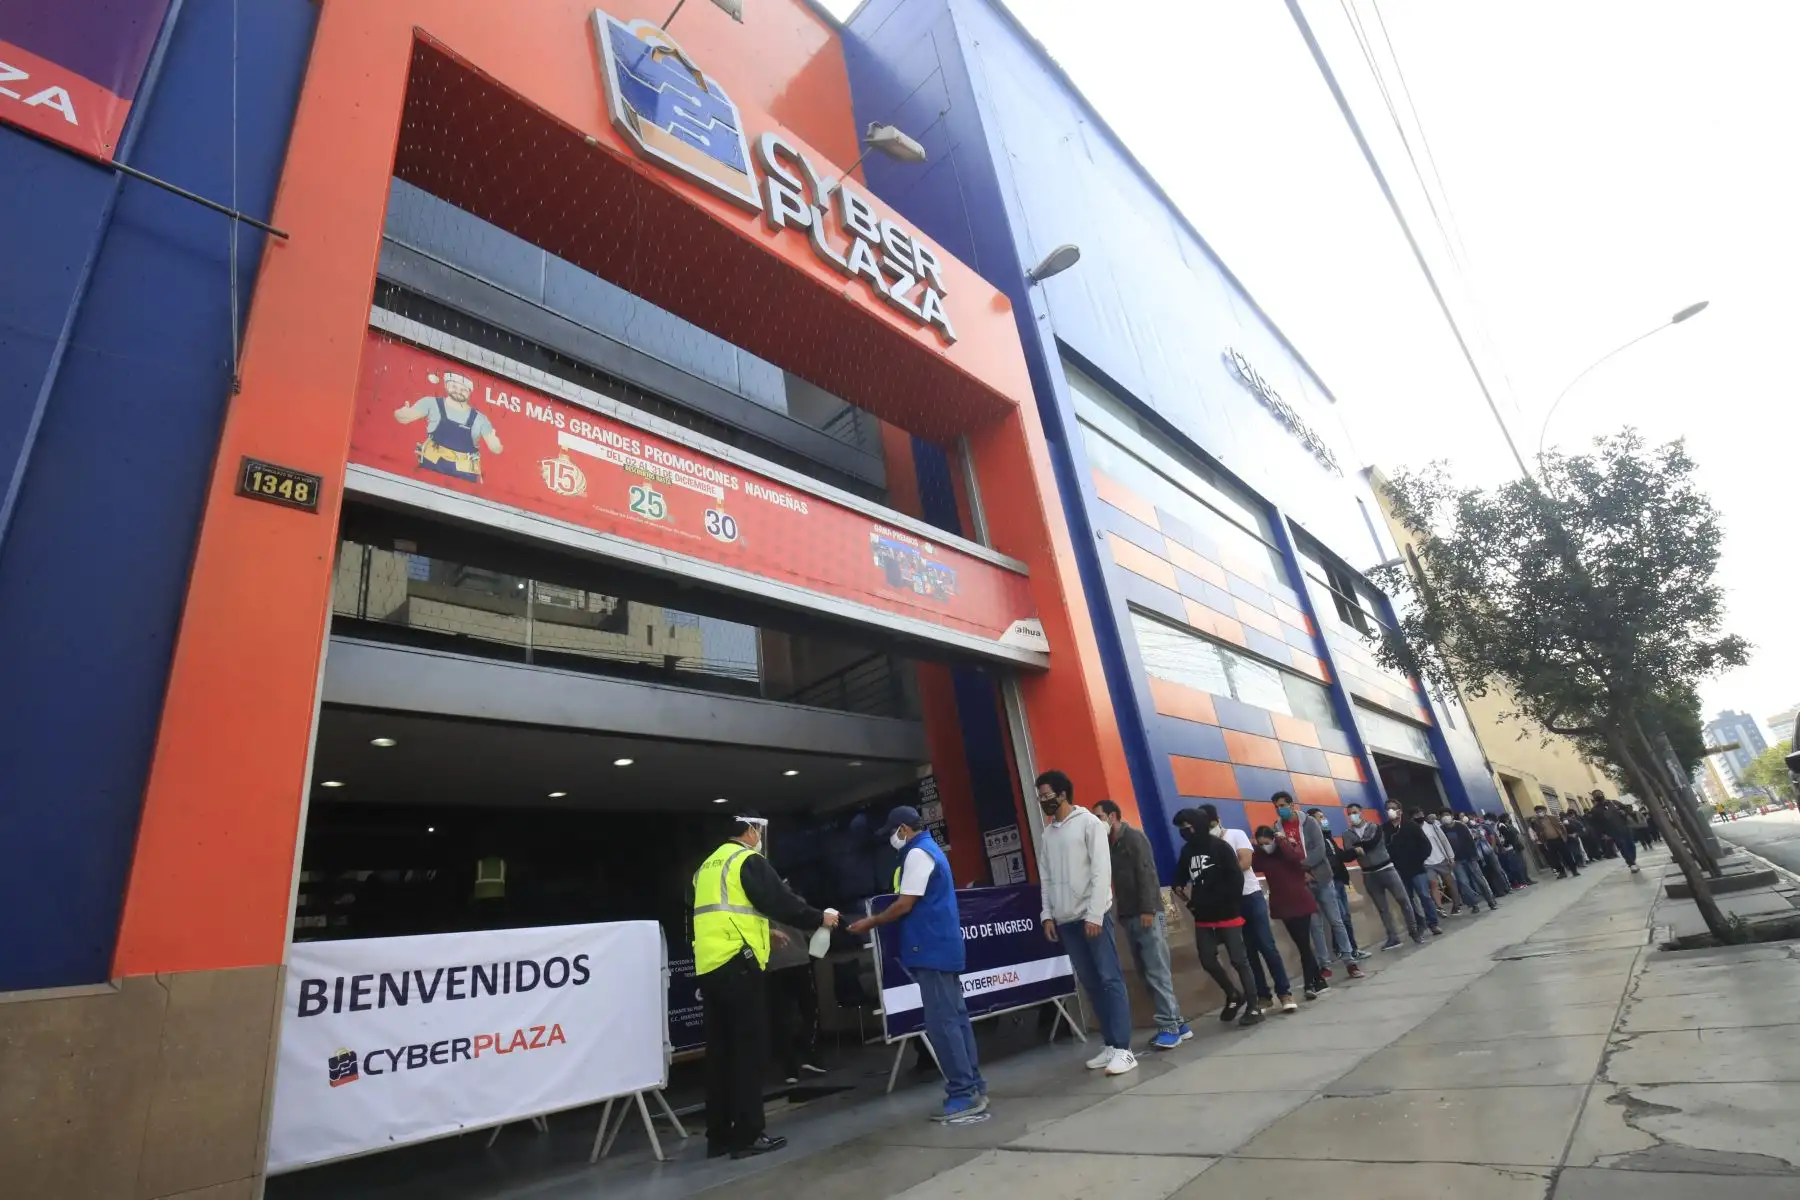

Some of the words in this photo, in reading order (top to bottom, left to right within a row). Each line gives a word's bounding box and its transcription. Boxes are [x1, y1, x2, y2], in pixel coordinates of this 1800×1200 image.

[757, 131, 948, 297] CYBER
[766, 175, 957, 343] PLAZA
[485, 387, 521, 413] LAS
[526, 402, 565, 429] MÁS
[569, 419, 640, 455] GRANDES
[644, 444, 739, 490] PROMOCIONES
[745, 482, 809, 515] NAVIDEÑAS
[253, 471, 309, 502] 1348
[542, 460, 577, 492] 15
[606, 449, 623, 463] DEL
[674, 474, 717, 495] DICIEMBRE
[630, 486, 664, 519] 25
[706, 510, 737, 540] 30
[980, 923, 994, 938] DE
[994, 918, 1033, 936] INGRESO
[297, 953, 591, 1018] BIENVENIDOS
[964, 971, 1020, 992] CYBERPLAZA
[362, 1022, 567, 1077] CYBERPLAZA
